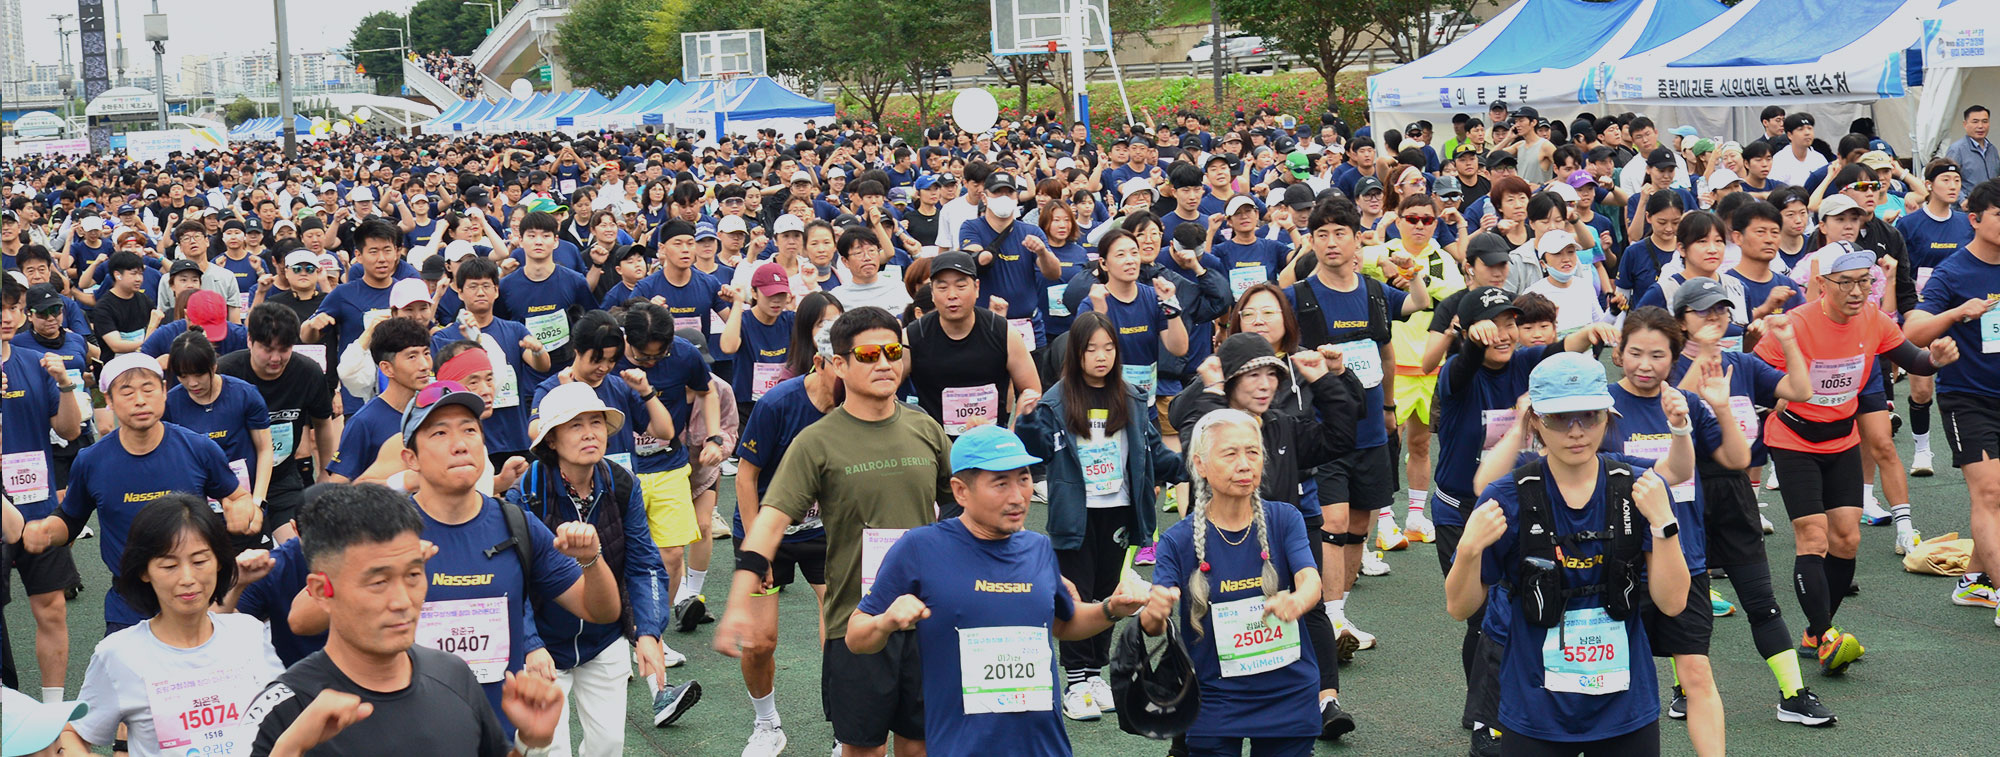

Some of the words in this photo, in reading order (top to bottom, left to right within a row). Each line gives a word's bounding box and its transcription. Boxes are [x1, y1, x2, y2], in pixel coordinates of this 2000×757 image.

[1657, 78, 1715, 99] 중랑마라톤
[1719, 77, 1771, 98] 신입회원
[1774, 75, 1800, 97] 모집
[1805, 71, 1852, 96] 접수처
[528, 304, 557, 313] Nassau
[1333, 319, 1369, 329] Nassau
[536, 328, 562, 341] 20925
[1821, 377, 1853, 389] 10053
[955, 405, 987, 418] 10925
[208, 430, 228, 439] sau
[844, 458, 898, 476] RAILROAD
[900, 456, 932, 468] BERLIN
[10, 472, 37, 486] 11509
[1622, 498, 1633, 536] AONIJIE
[432, 571, 495, 587] Nassau
[975, 578, 1033, 594] Nassau
[1220, 576, 1265, 594] Nassa
[436, 634, 490, 654] 10407
[1232, 624, 1284, 649] 25024
[1563, 643, 1615, 663] 55278
[983, 662, 1036, 681] 20120
[1239, 655, 1285, 672] XyliMelts
[179, 702, 240, 731] 15074
[204, 730, 224, 741] 1518
